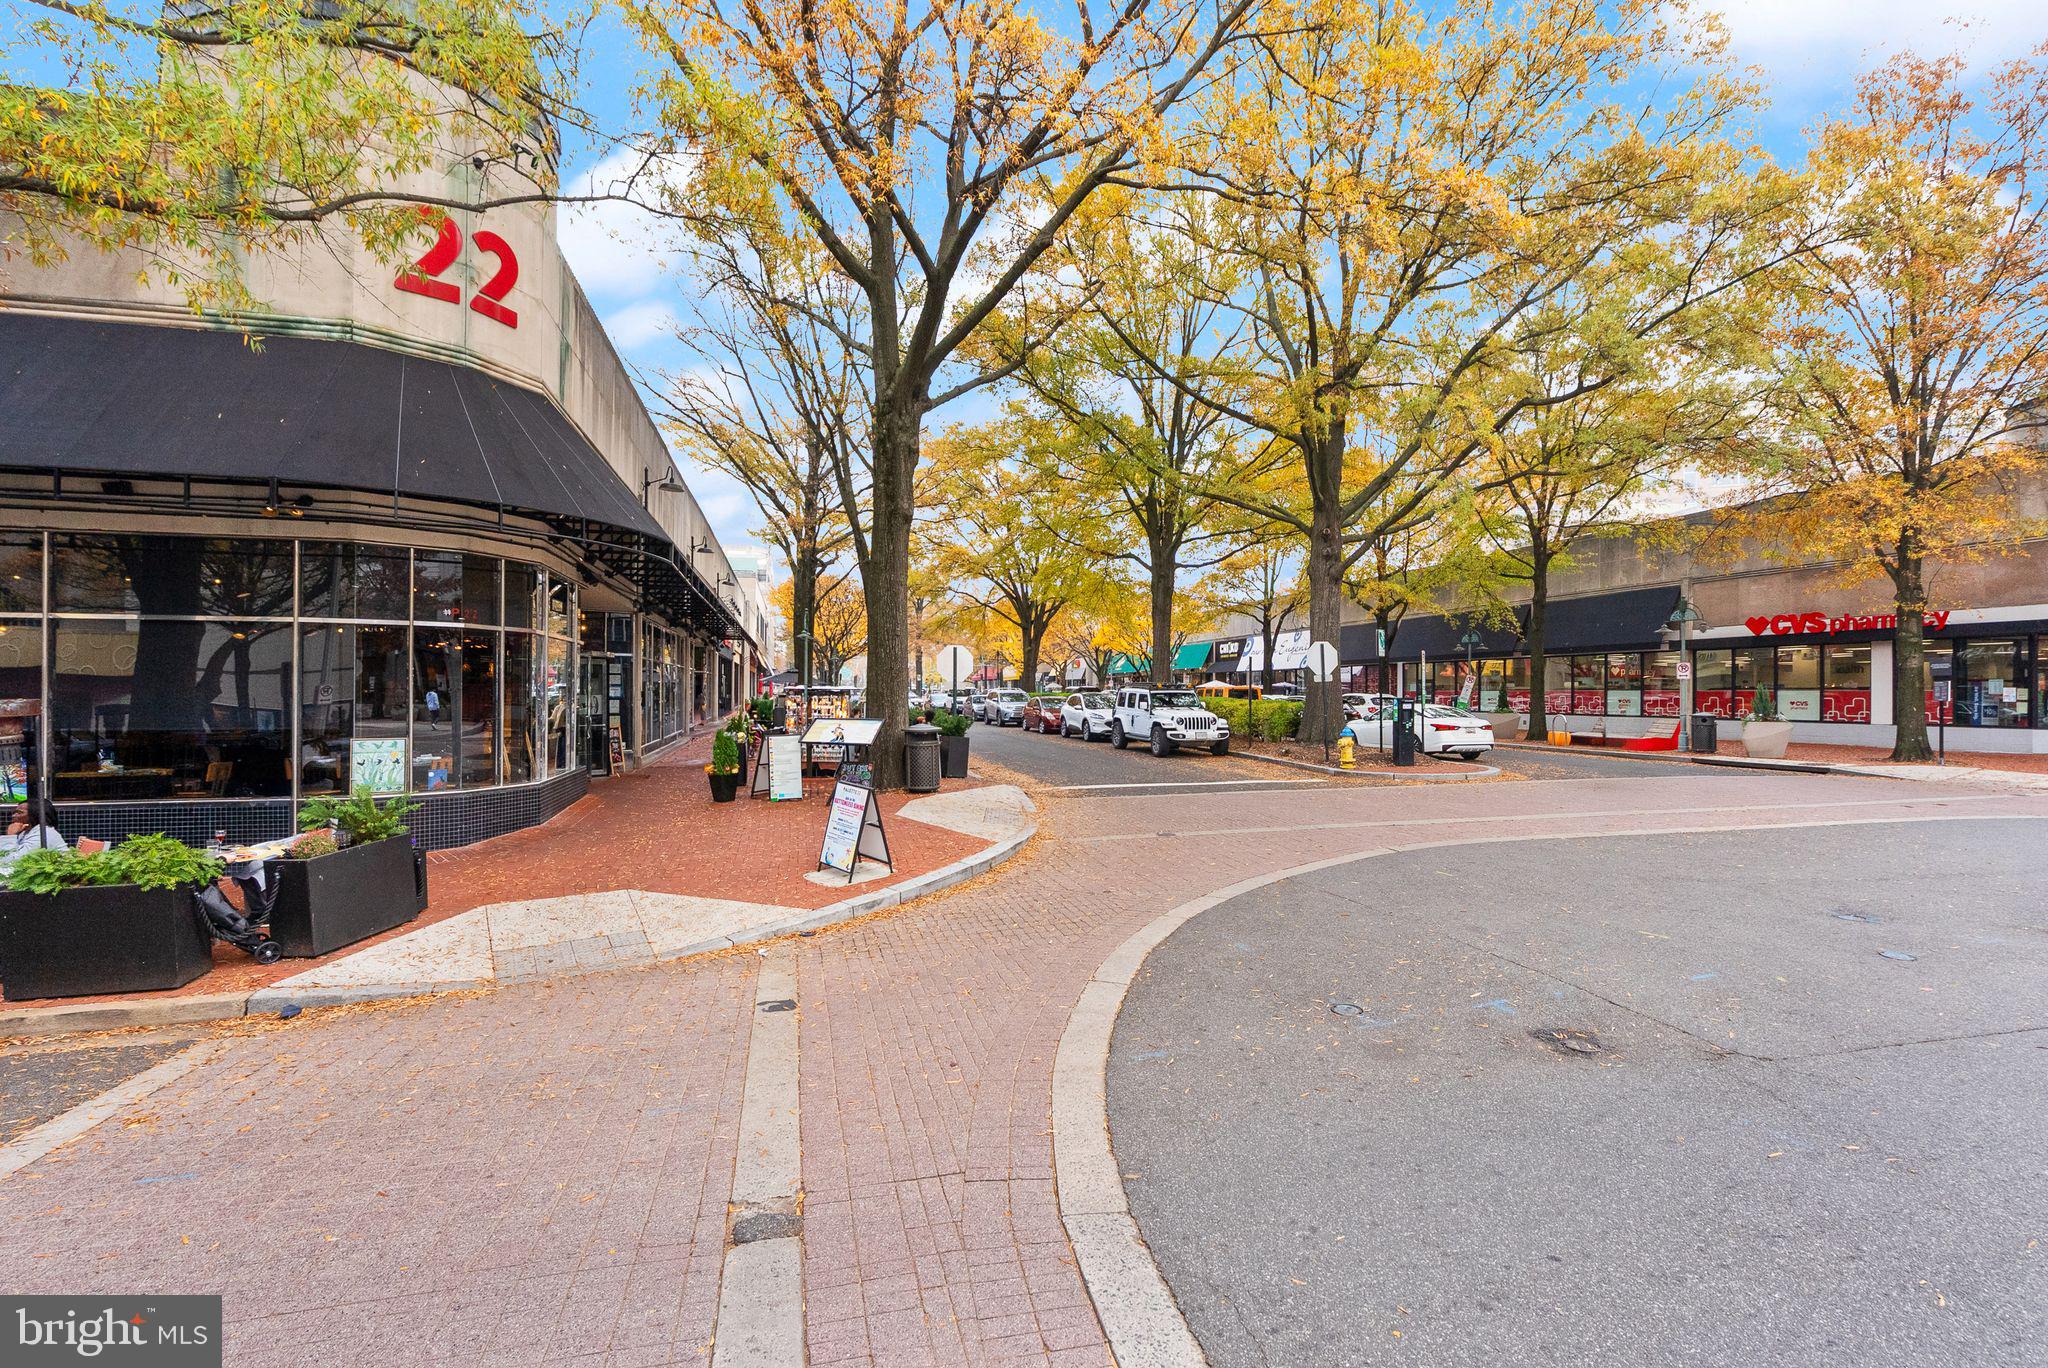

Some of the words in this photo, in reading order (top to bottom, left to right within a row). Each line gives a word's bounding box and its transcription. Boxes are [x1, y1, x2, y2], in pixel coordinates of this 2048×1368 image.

[394, 204, 519, 330] 22
[1770, 612, 1826, 635] CVS
[1829, 610, 1950, 637] pharmcy
[1279, 640, 1309, 662] Eugeni
